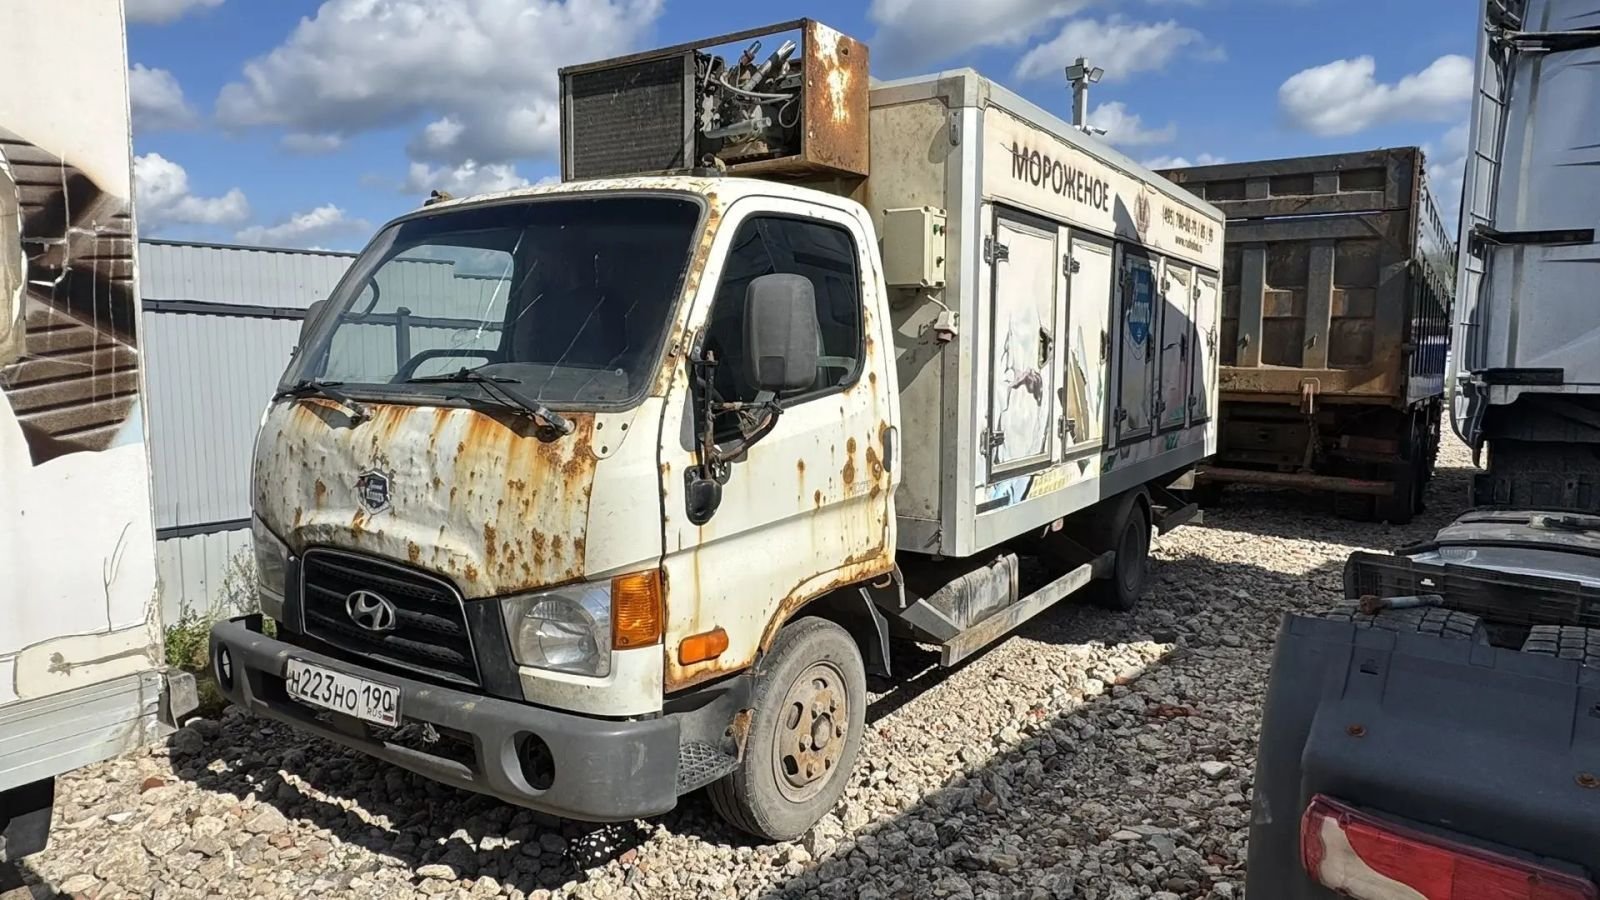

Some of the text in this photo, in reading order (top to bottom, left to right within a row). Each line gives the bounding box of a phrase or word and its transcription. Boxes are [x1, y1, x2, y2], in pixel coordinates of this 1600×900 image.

[1012, 141, 1109, 212] МОРОЖЕНОЕ
[291, 668, 392, 712] Н223НО 190
[367, 708, 383, 719] RUS
